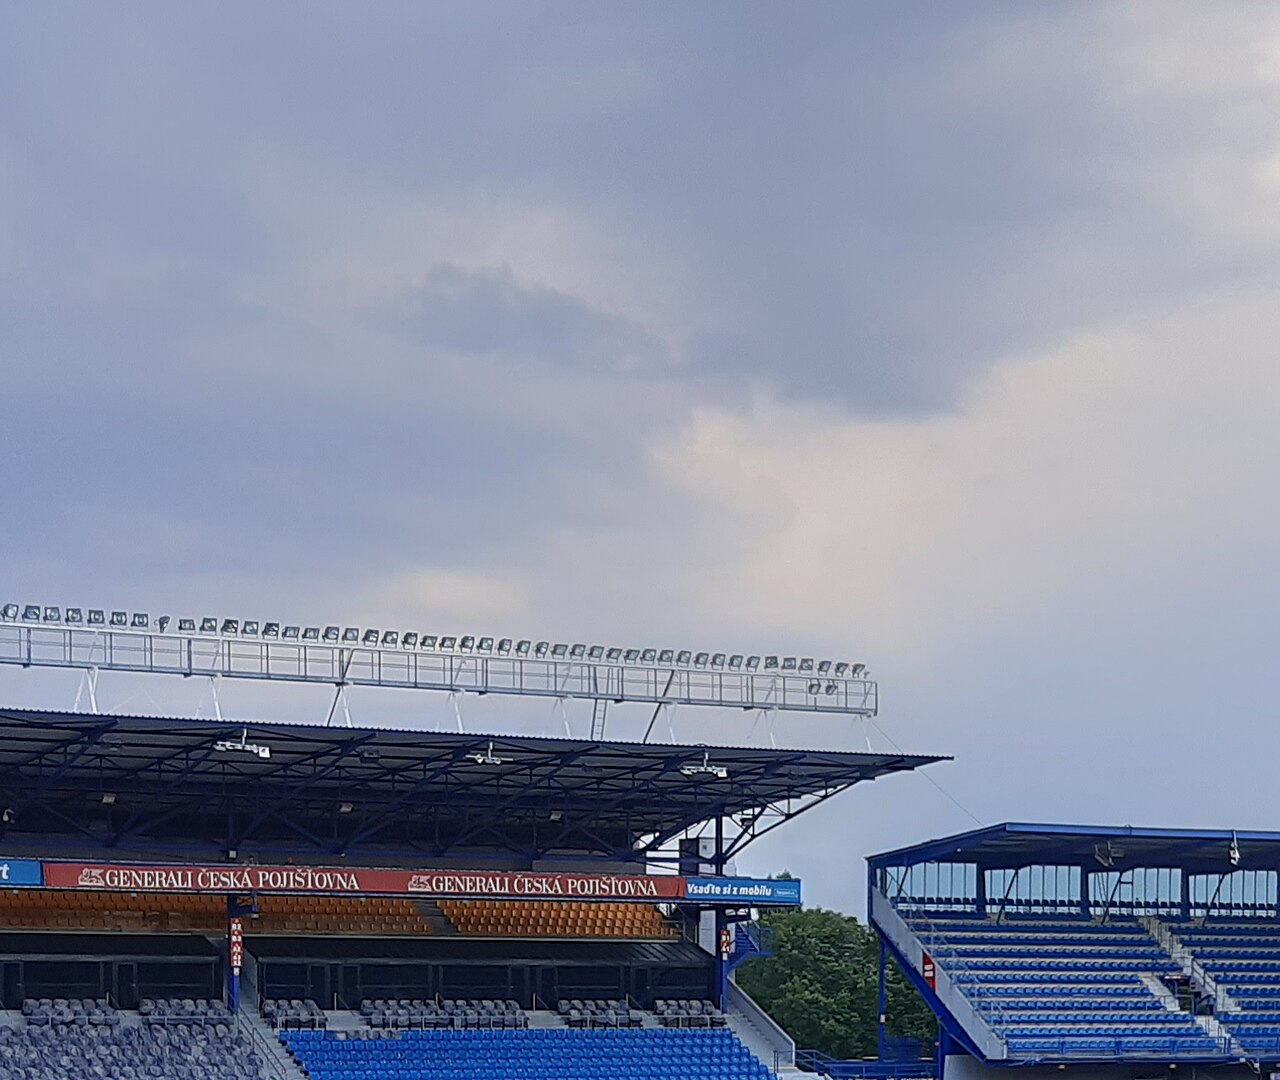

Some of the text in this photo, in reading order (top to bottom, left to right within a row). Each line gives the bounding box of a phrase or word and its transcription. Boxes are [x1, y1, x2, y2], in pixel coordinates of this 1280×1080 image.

[105, 868, 361, 891] GENERALI ČESKÁ POJIŠŤOVNA
[431, 874, 658, 897] GENERALI ČESKÁ POJIŠŤOVNA
[687, 883, 721, 895] Vsaďte
[723, 884, 732, 895] si
[732, 886, 738, 895] z
[739, 885, 772, 897] mobilu
